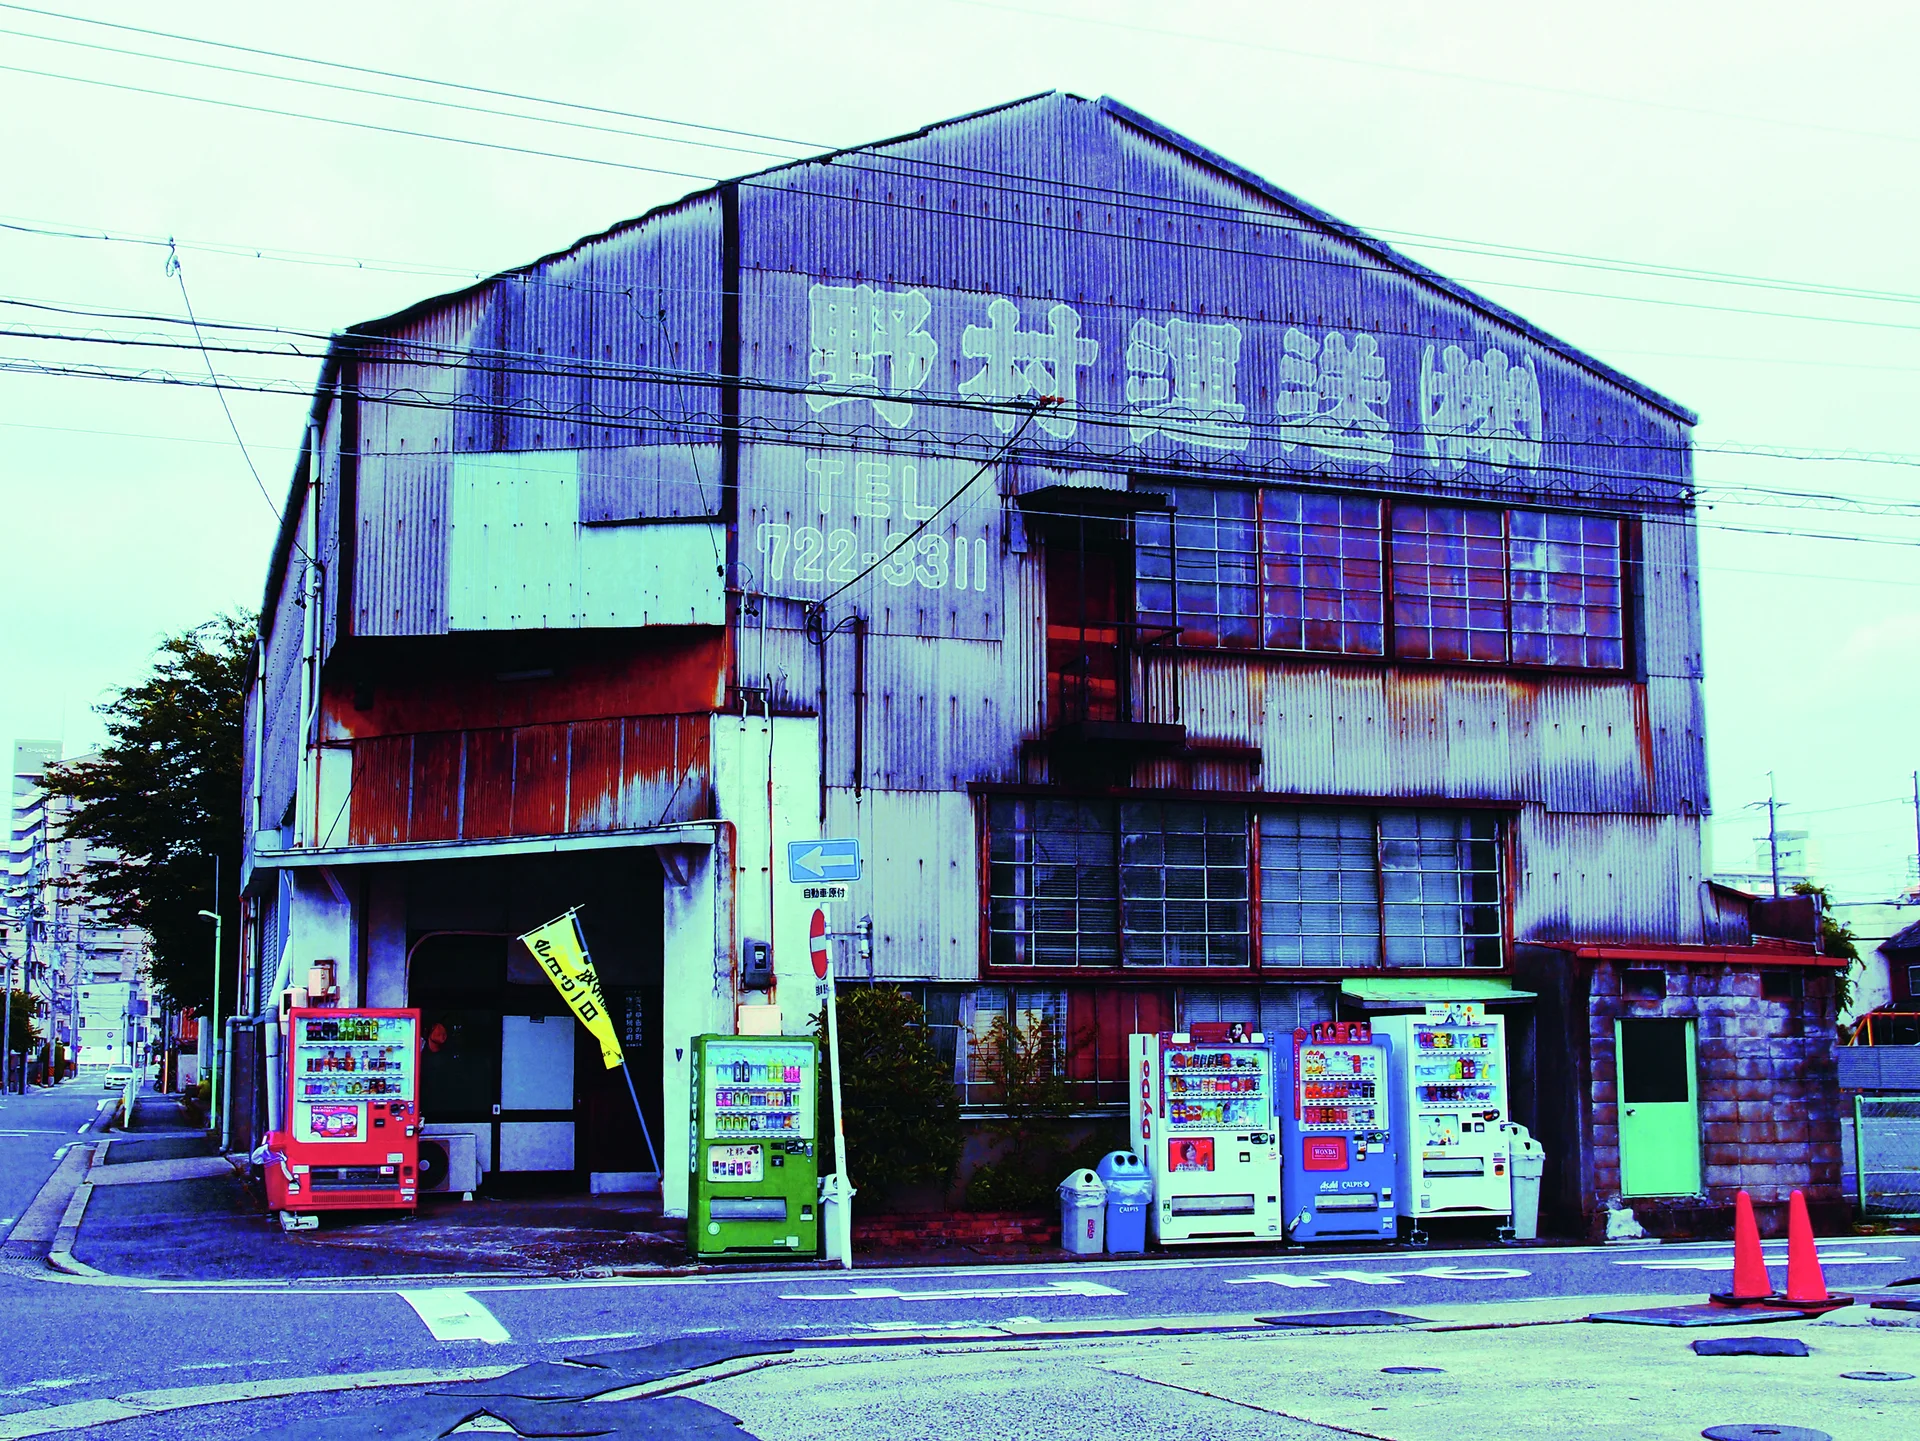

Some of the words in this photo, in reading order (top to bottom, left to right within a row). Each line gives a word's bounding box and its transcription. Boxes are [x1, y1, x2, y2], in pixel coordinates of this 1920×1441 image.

[805, 458, 939, 520] TEL
[756, 523, 988, 592] 722-3311
[690, 1051, 699, 1174] SAPPORO
[1341, 1180, 1364, 1190] CALPIS
